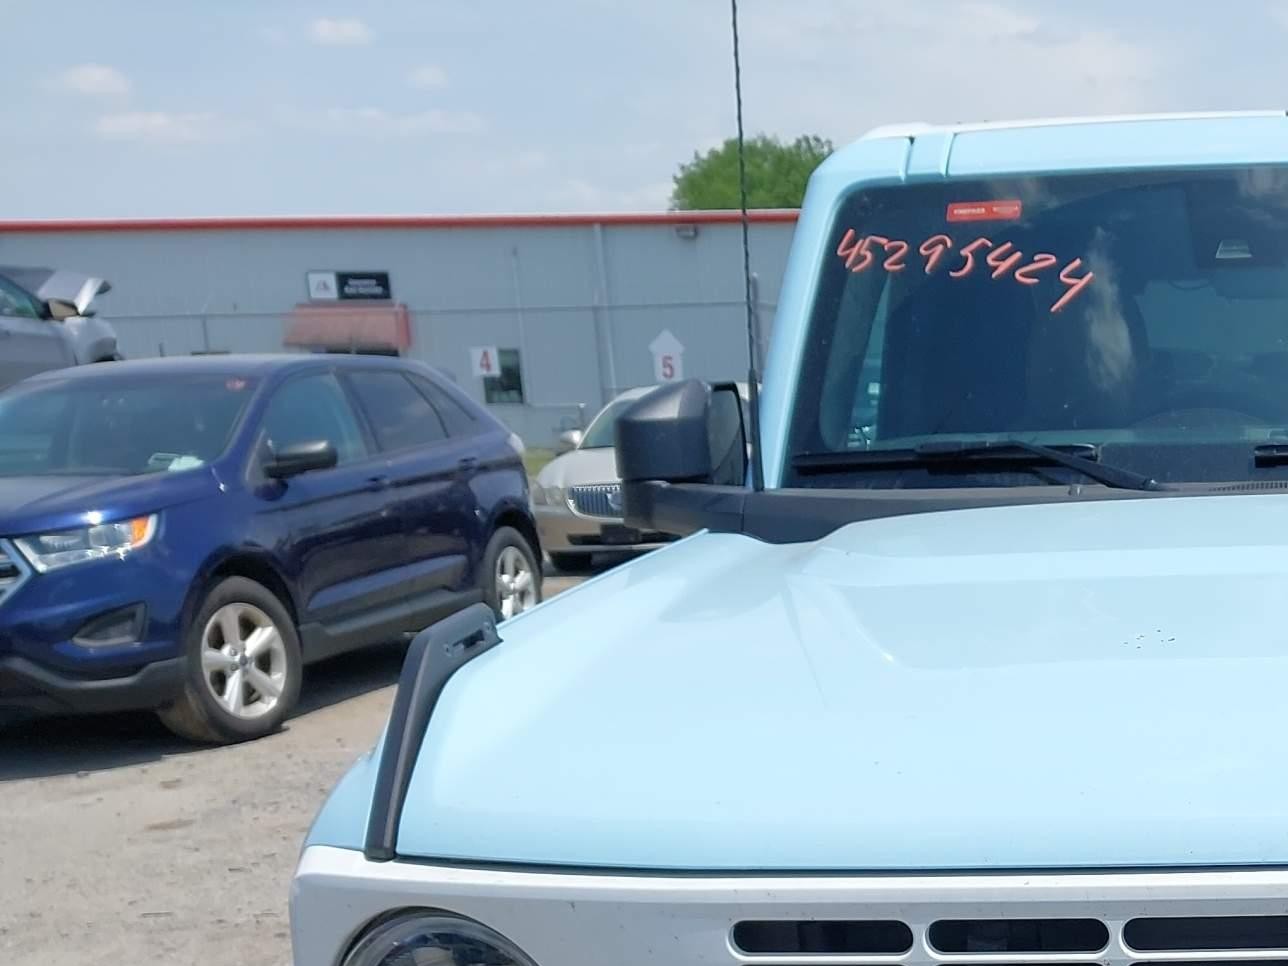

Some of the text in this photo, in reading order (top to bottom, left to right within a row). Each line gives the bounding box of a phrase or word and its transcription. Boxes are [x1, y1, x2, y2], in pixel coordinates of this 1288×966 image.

[836, 228, 1094, 313] 45295424
[479, 350, 492, 373] 4
[661, 355, 675, 379] 5
